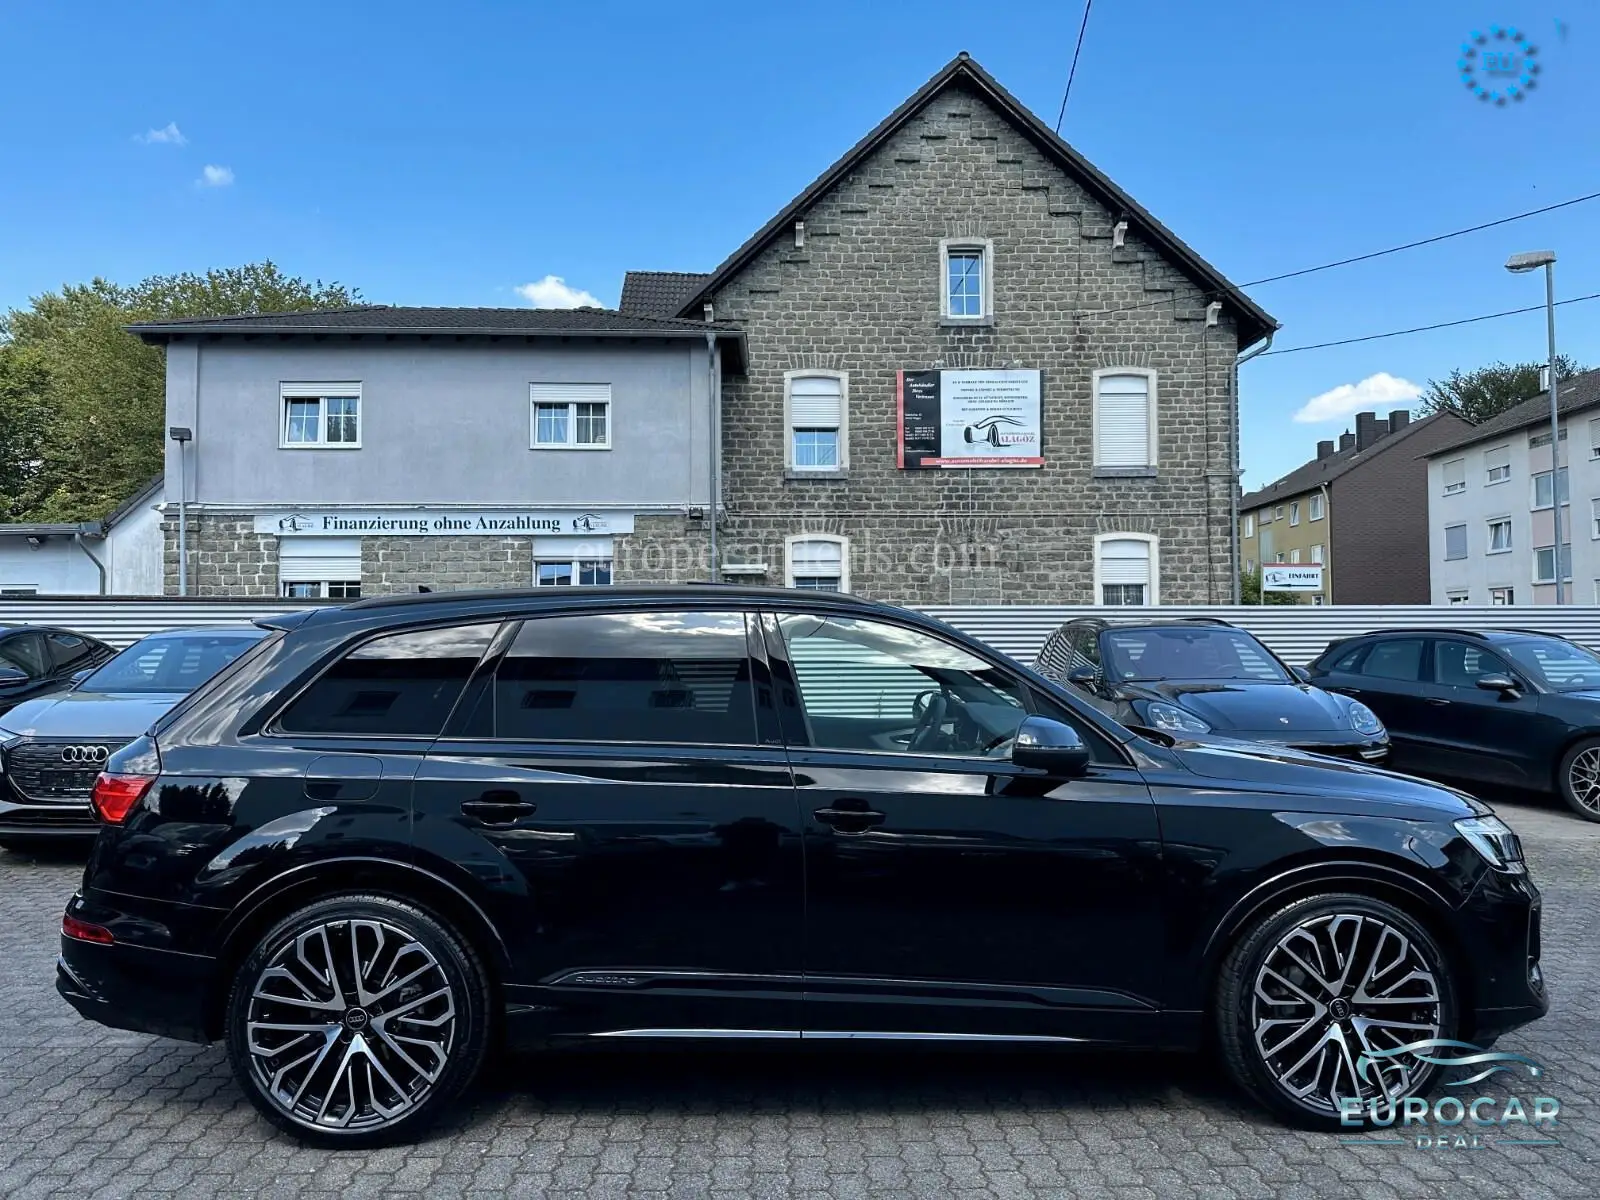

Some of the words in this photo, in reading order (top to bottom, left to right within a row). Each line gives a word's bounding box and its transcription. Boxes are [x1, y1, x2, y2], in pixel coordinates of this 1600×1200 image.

[323, 516, 429, 532] Finanzierung
[433, 516, 471, 530] ohne
[476, 516, 561, 533] Anzahlung
